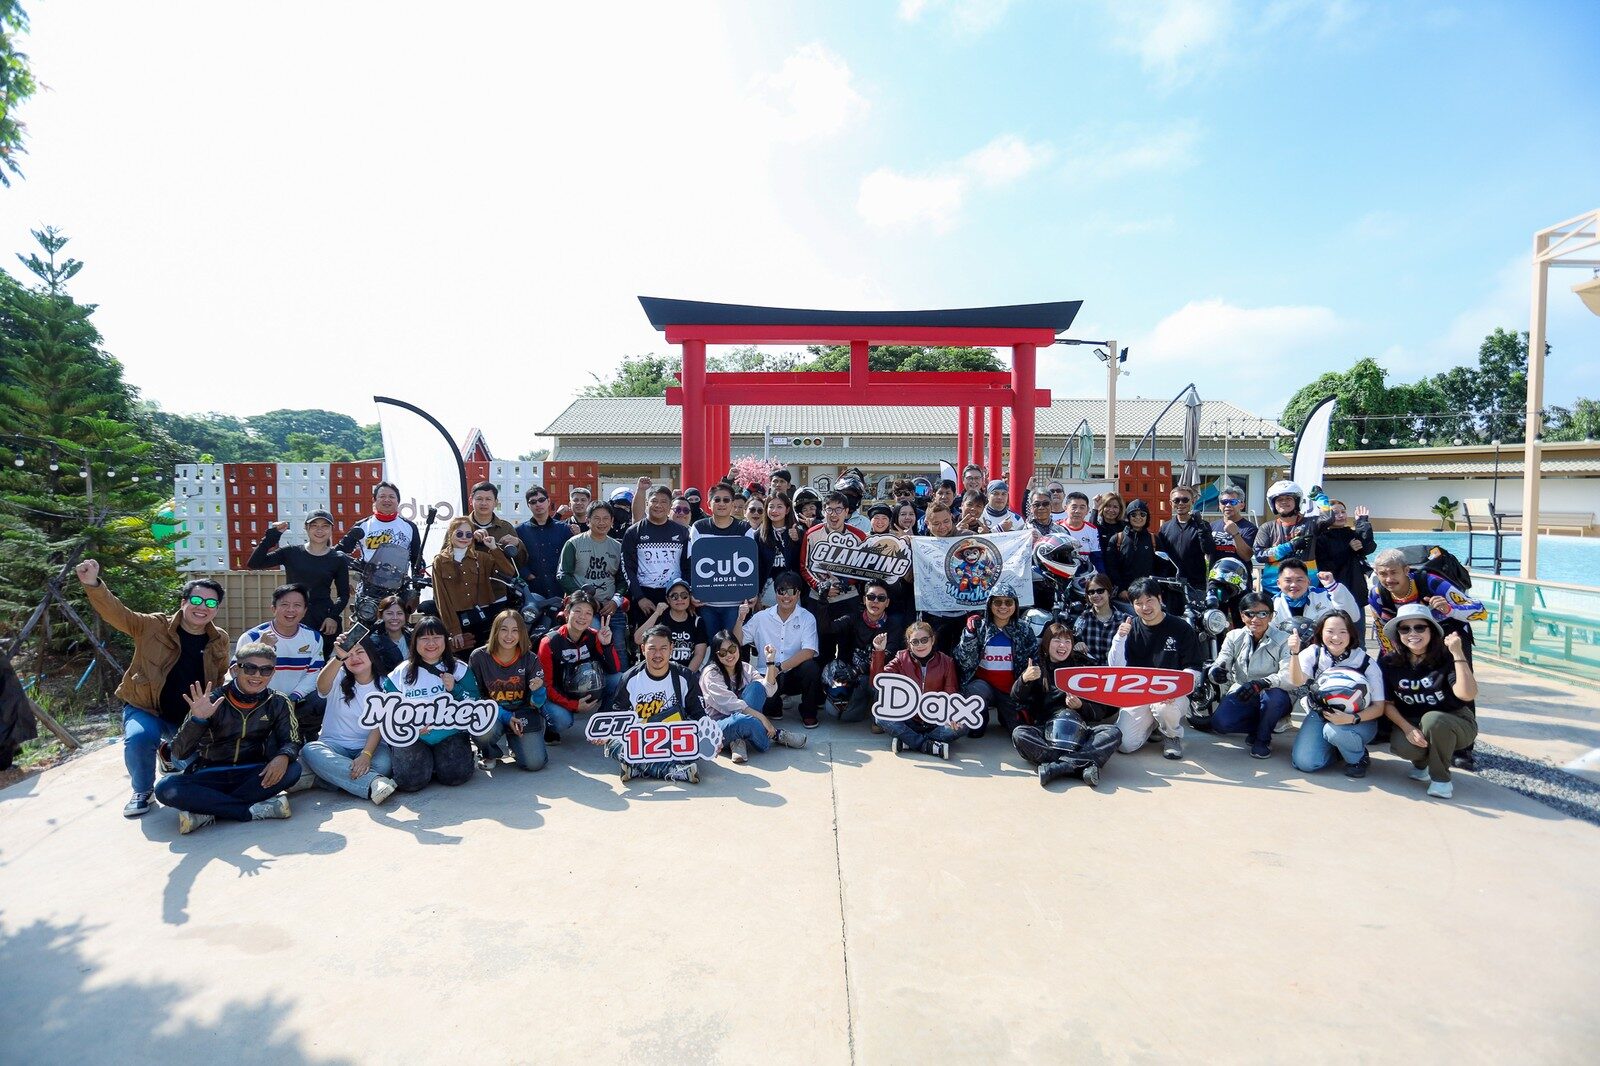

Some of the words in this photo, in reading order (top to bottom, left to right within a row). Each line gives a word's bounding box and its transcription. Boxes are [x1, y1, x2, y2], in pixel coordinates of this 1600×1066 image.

[813, 544, 909, 576] GLAMPING
[405, 688, 428, 698] RIDE
[1067, 673, 1180, 695] C125
[1399, 677, 1432, 690] CUB
[874, 675, 982, 727] Dax
[1394, 690, 1445, 705] HOUSE
[361, 695, 496, 744] Monkey
[635, 699, 666, 719] PLAY
[589, 715, 635, 738] CT
[624, 725, 698, 759] 125
